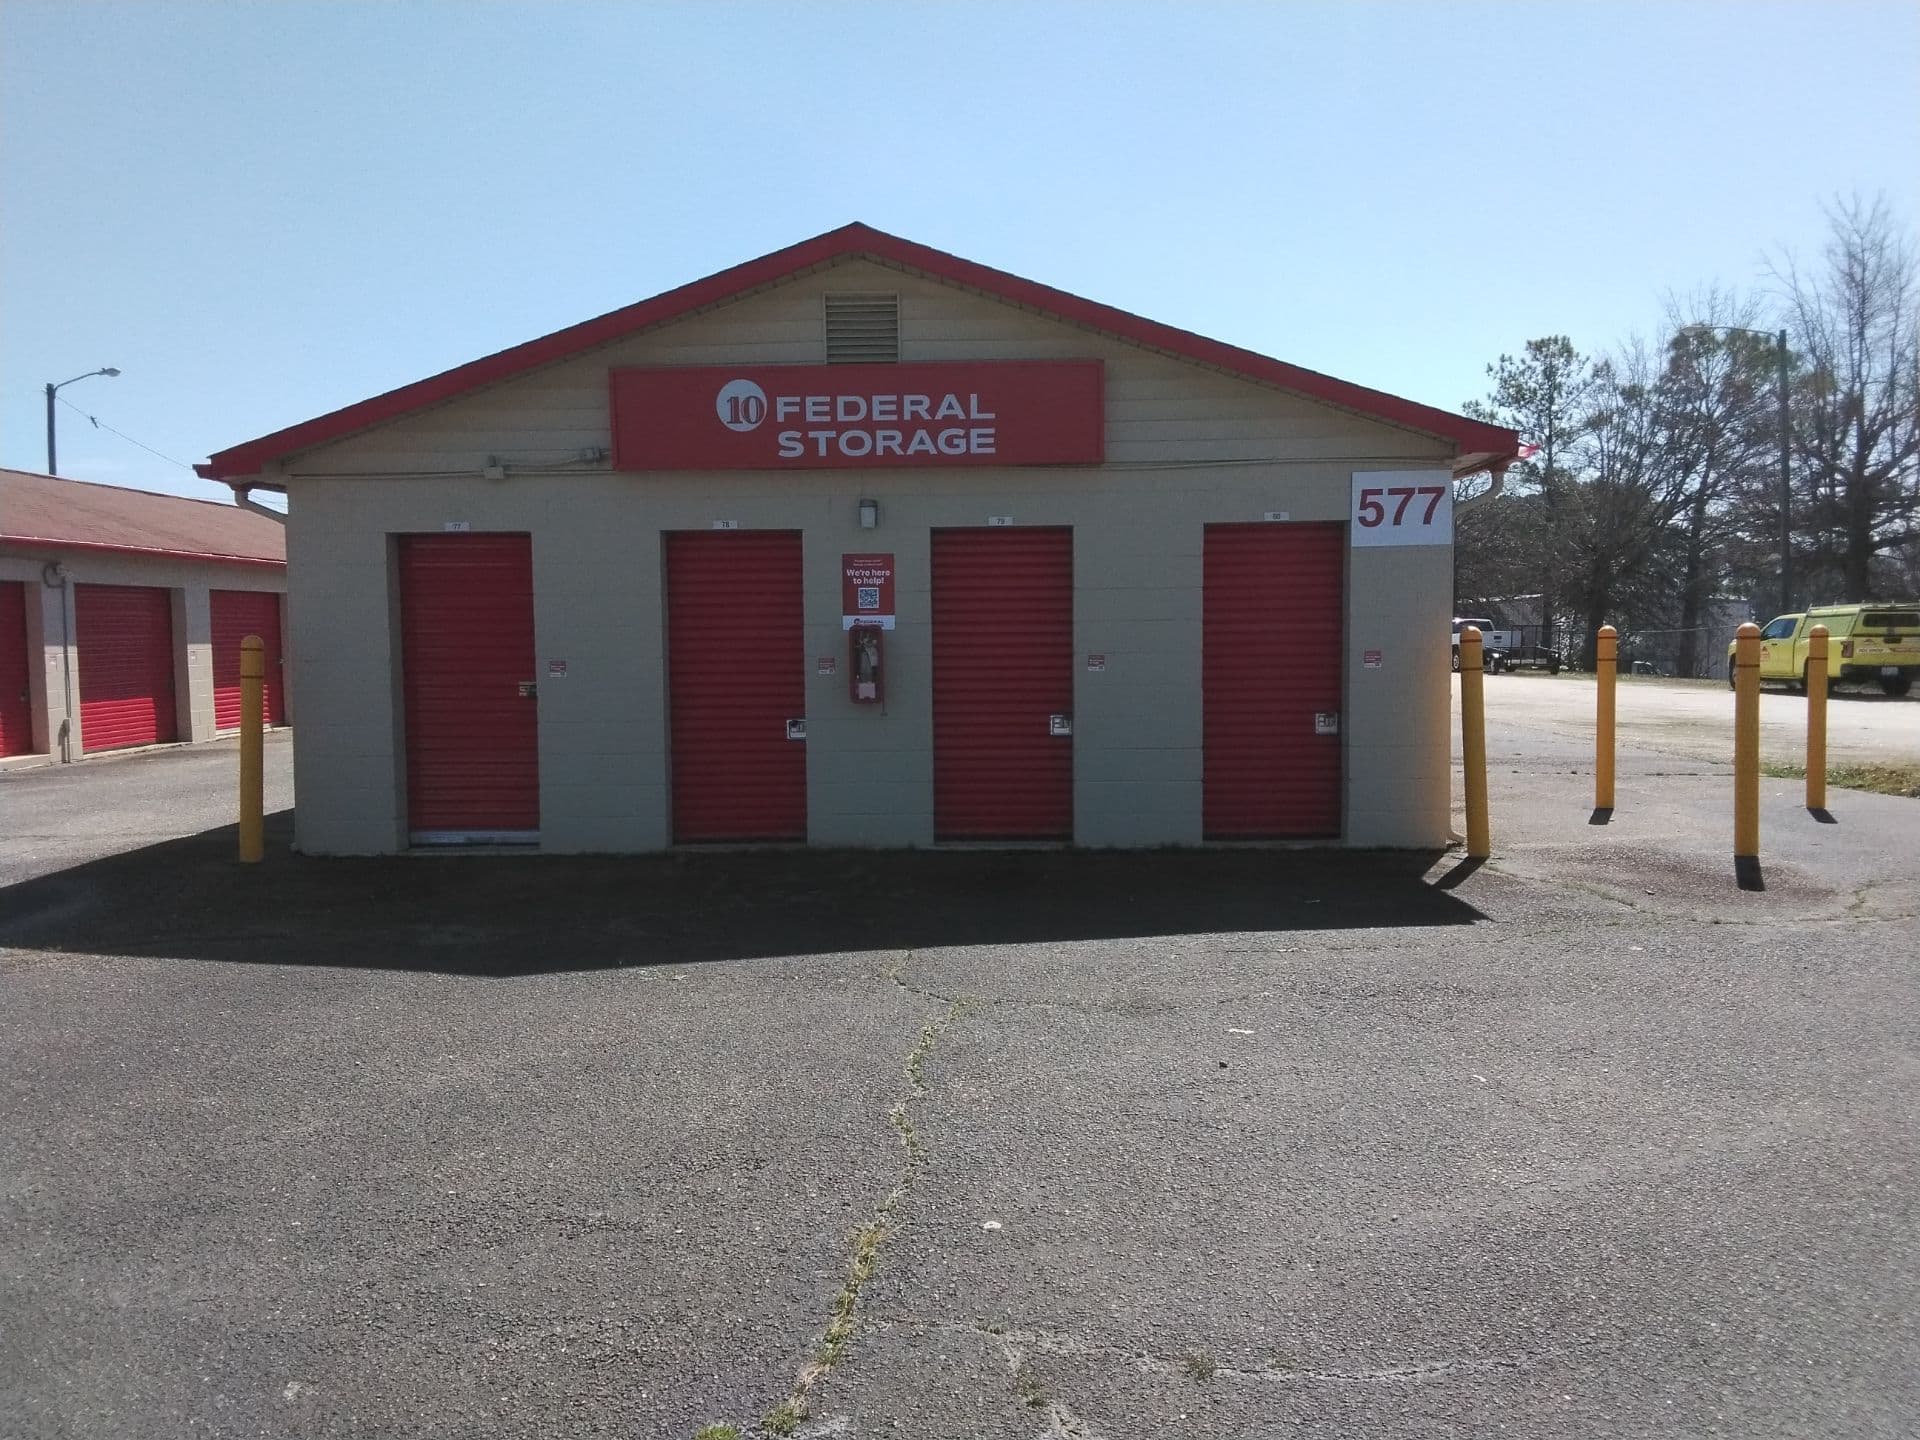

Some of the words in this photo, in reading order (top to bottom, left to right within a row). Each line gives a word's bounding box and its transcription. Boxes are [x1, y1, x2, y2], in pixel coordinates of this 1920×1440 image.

[727, 396, 764, 425] 10
[776, 394, 996, 422] FEDERAL
[778, 428, 996, 457] STORAGE
[1358, 486, 1445, 528] 577
[863, 577, 884, 586] help!
